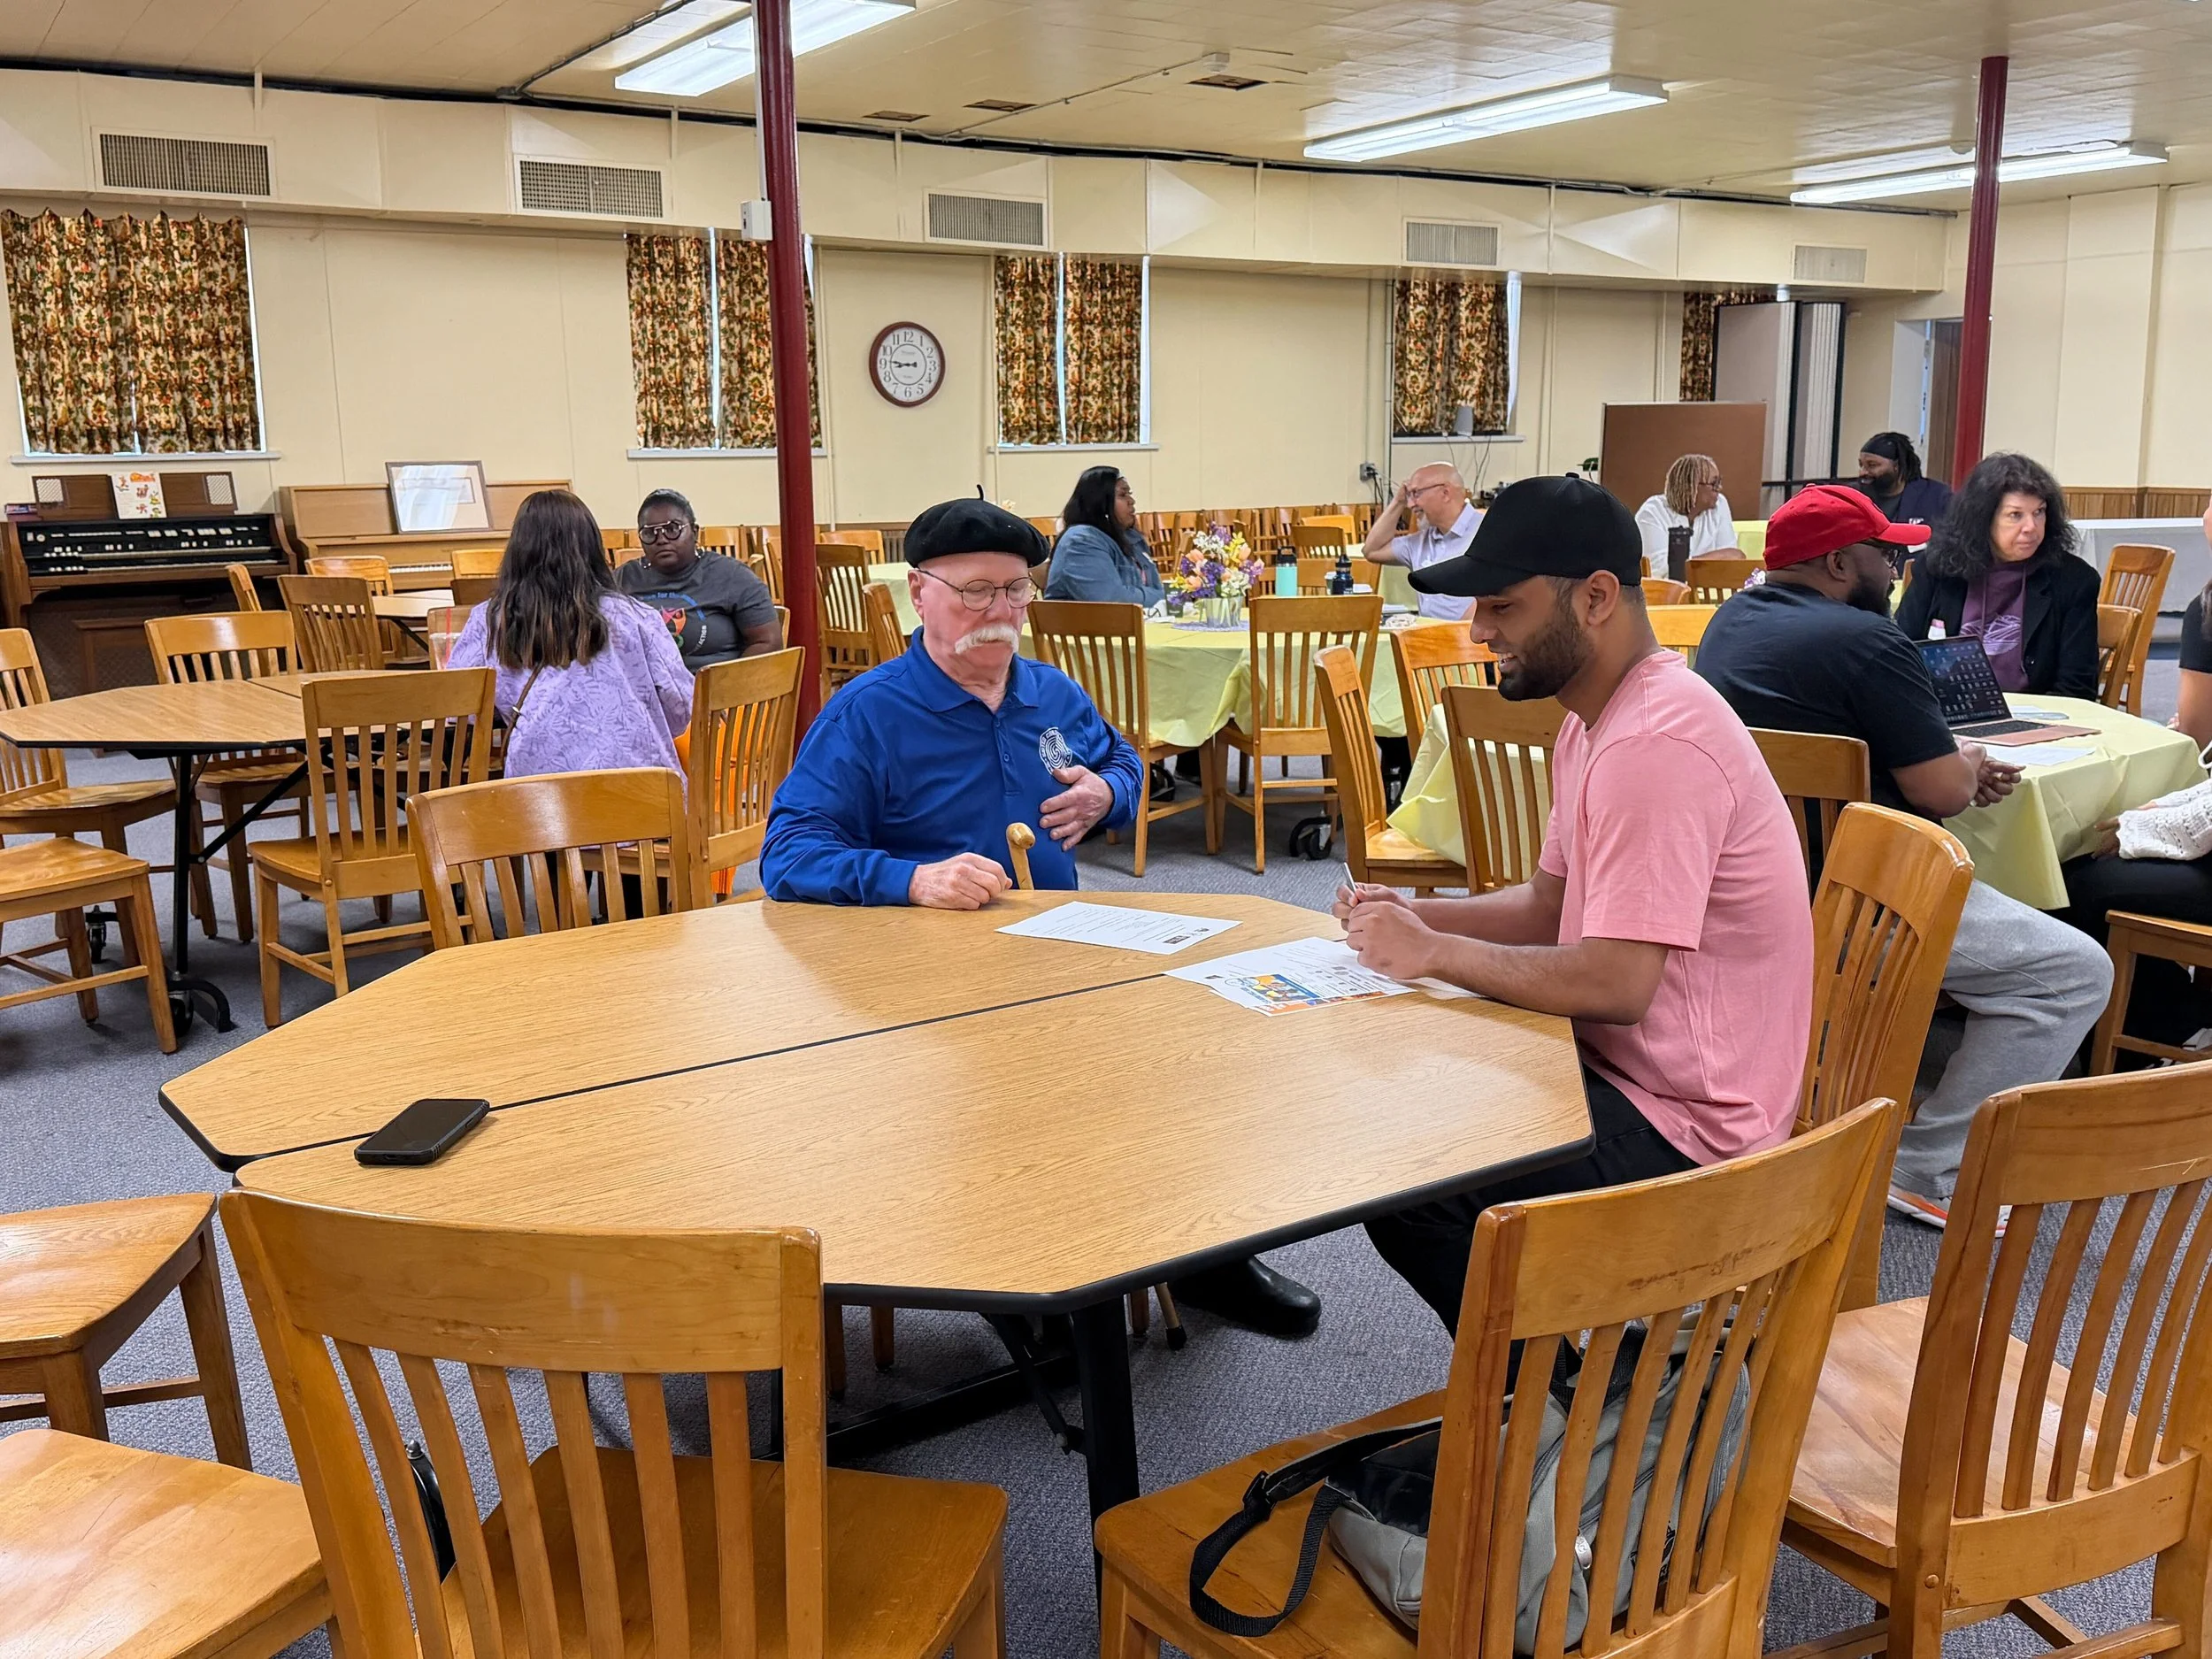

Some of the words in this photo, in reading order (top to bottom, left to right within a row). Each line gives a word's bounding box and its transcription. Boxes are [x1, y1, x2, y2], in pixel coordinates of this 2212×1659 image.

[893, 334, 900, 345] 11
[903, 331, 914, 342] 12
[919, 335, 923, 347] 1
[882, 345, 892, 357] 10
[926, 347, 933, 358] 2
[879, 358, 887, 370] 9
[928, 360, 936, 372] 3
[883, 371, 891, 382] 8
[925, 373, 933, 384] 4
[892, 382, 900, 395] 7
[904, 387, 911, 398] 6
[917, 383, 925, 395] 5
